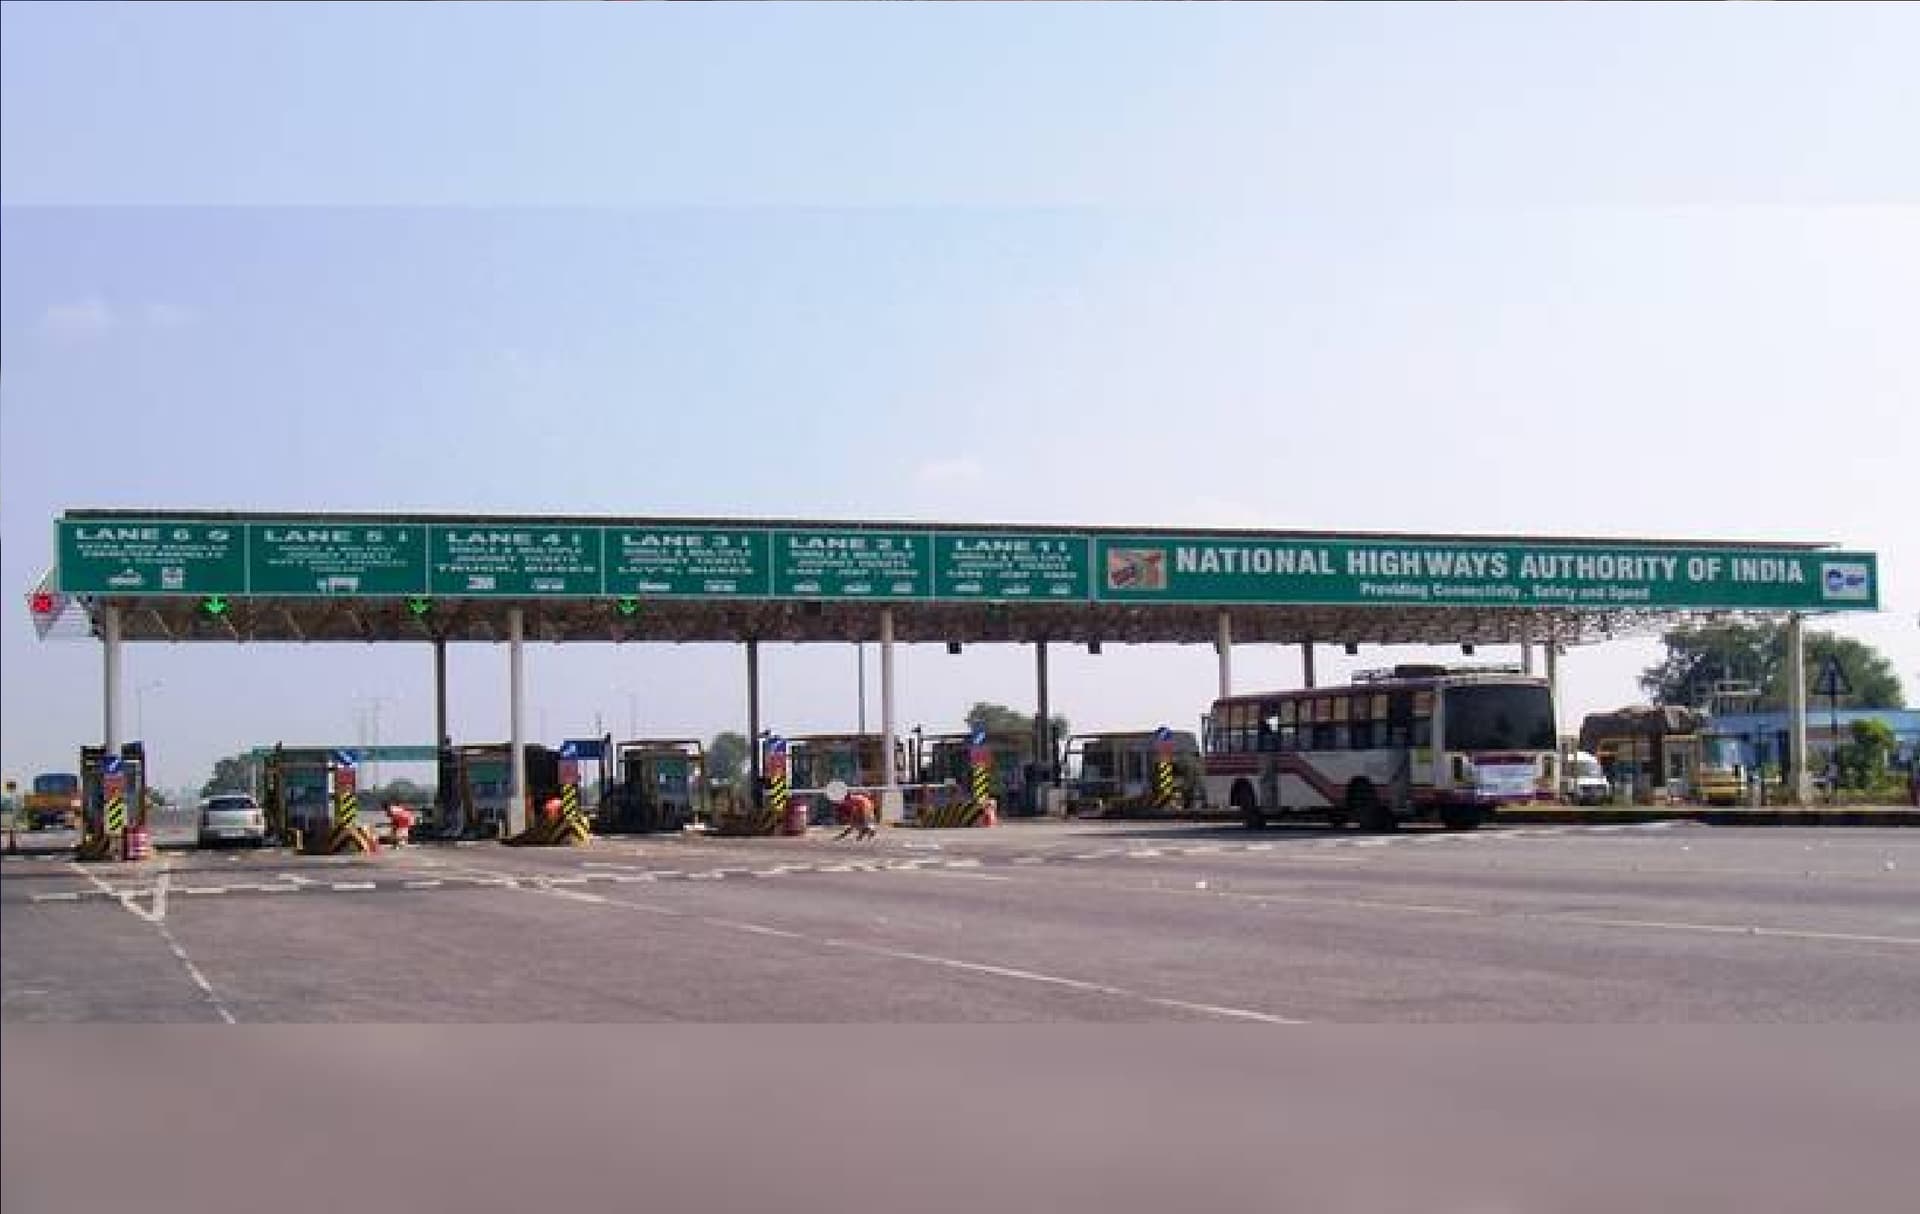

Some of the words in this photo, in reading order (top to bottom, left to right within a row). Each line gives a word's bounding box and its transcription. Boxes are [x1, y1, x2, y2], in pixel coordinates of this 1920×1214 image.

[76, 527, 160, 541] LANE
[264, 530, 353, 543] LANE
[446, 531, 532, 546] LANE
[542, 533, 560, 546] 4
[622, 534, 705, 547] LANE
[788, 536, 866, 549] LANE
[956, 539, 1031, 551] LANE
[1175, 546, 1337, 575] NATIONAL
[1346, 549, 1508, 579] HIGHWAYS
[1520, 552, 1678, 582] AUTHORITY
[1687, 556, 1722, 582] OF
[1731, 557, 1805, 584] INDIA
[1360, 582, 1429, 600] Providing
[1532, 584, 1575, 601] Safety
[1578, 586, 1604, 598] and
